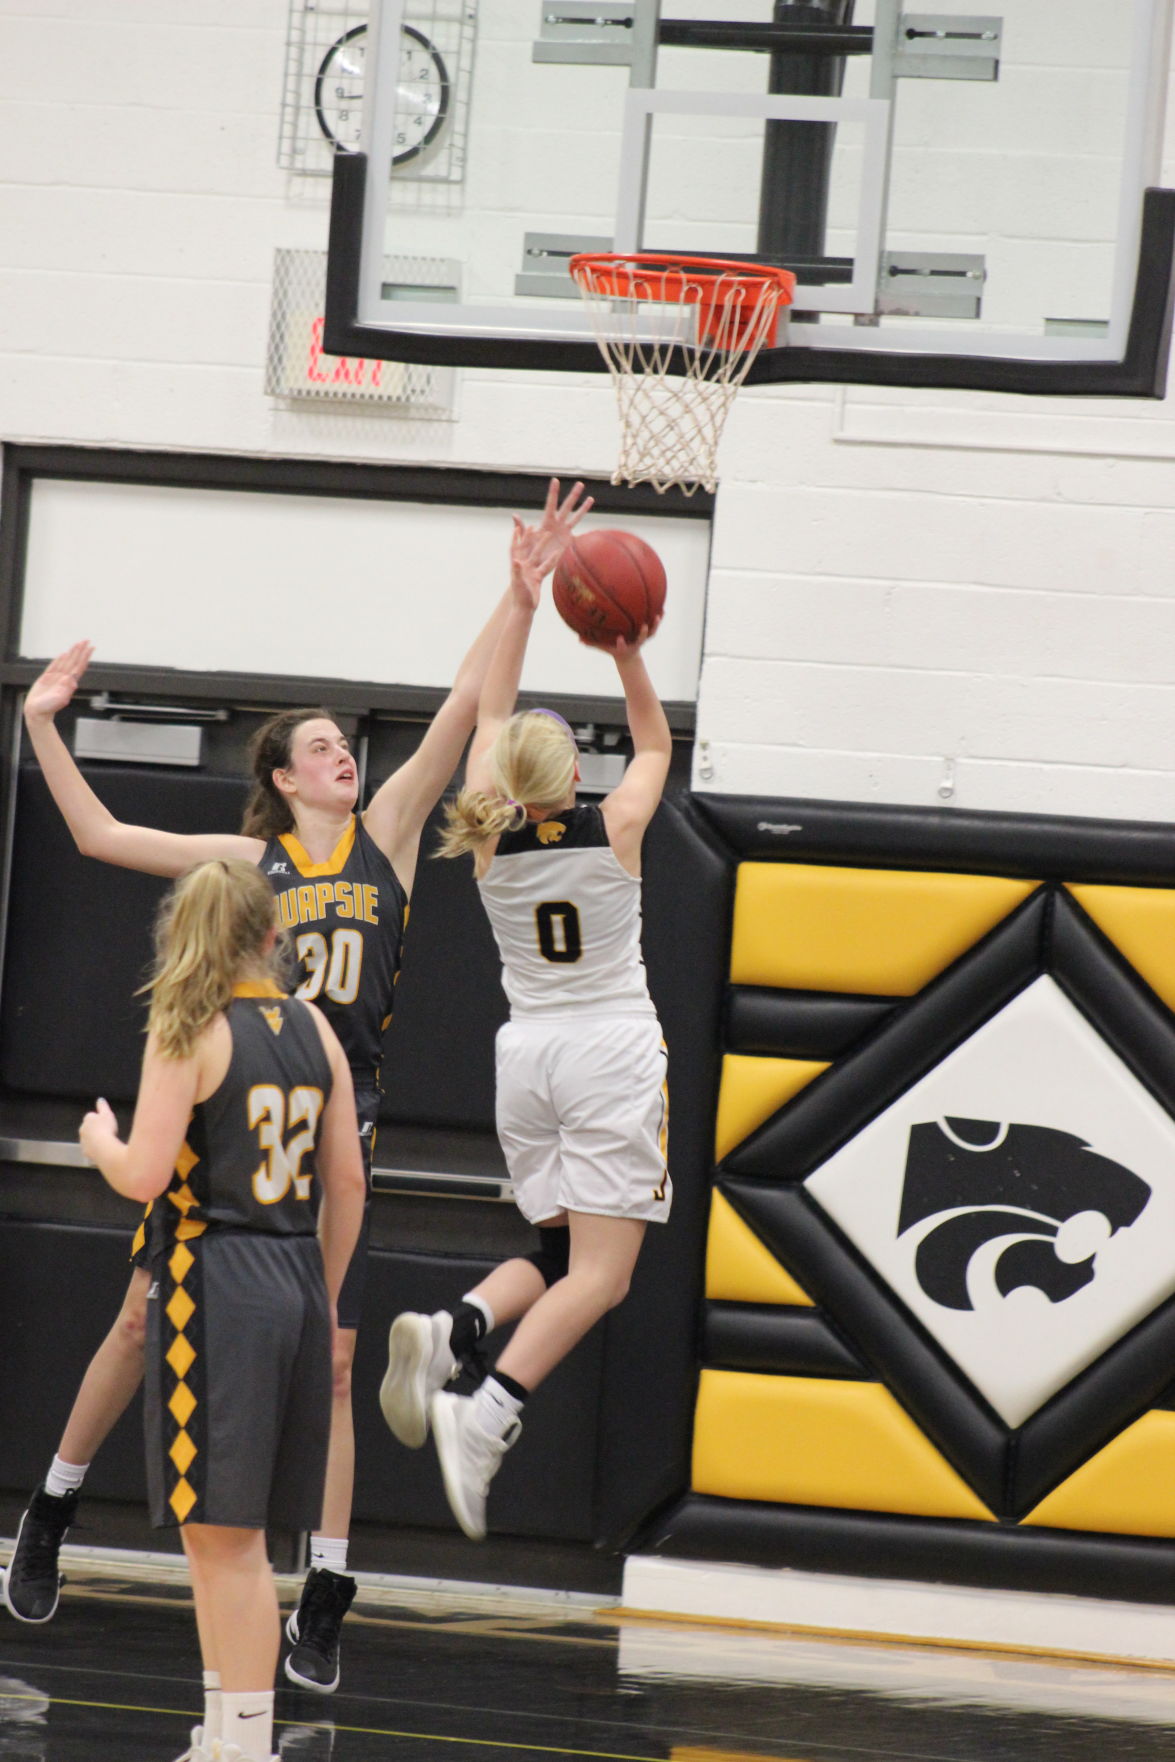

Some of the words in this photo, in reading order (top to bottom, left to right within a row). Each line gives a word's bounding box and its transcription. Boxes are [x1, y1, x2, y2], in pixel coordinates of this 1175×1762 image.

[294, 927, 363, 1005] 30
[534, 900, 582, 964] 0
[247, 1084, 324, 1205] 32
